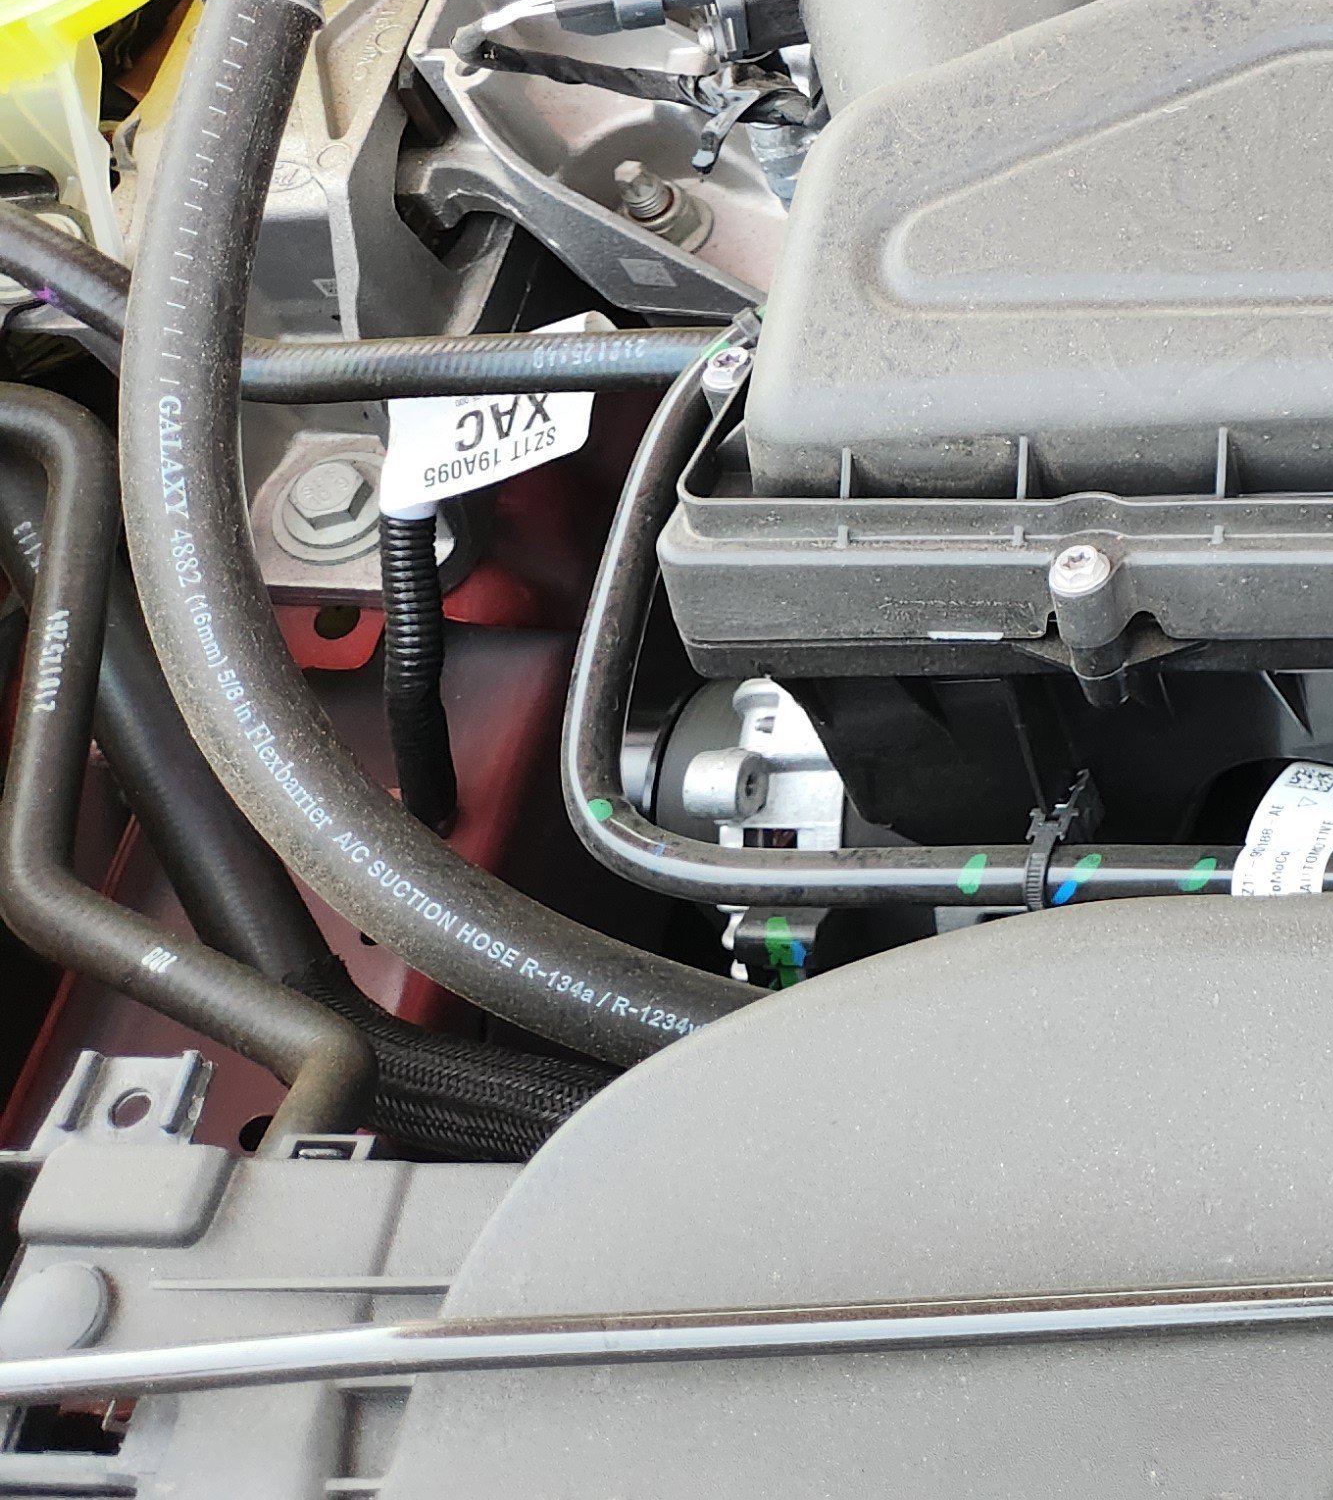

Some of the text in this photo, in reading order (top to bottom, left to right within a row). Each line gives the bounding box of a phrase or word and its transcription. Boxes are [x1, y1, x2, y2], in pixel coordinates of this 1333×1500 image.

[455, 393, 552, 453] XAC
[158, 394, 190, 520] GALAXY
[424, 426, 556, 488] SZ1T 19A095
[170, 528, 202, 589] 4882
[184, 594, 229, 669] (16mm)
[217, 669, 245, 701] 5/8
[233, 701, 253, 723] in
[244, 720, 333, 830] Flexbarrier
[332, 830, 370, 863] A/C
[367, 859, 459, 931] SUCTION
[455, 921, 520, 968] HOSE
[519, 956, 595, 1004] R-134a
[611, 994, 708, 1037] R-1234y
